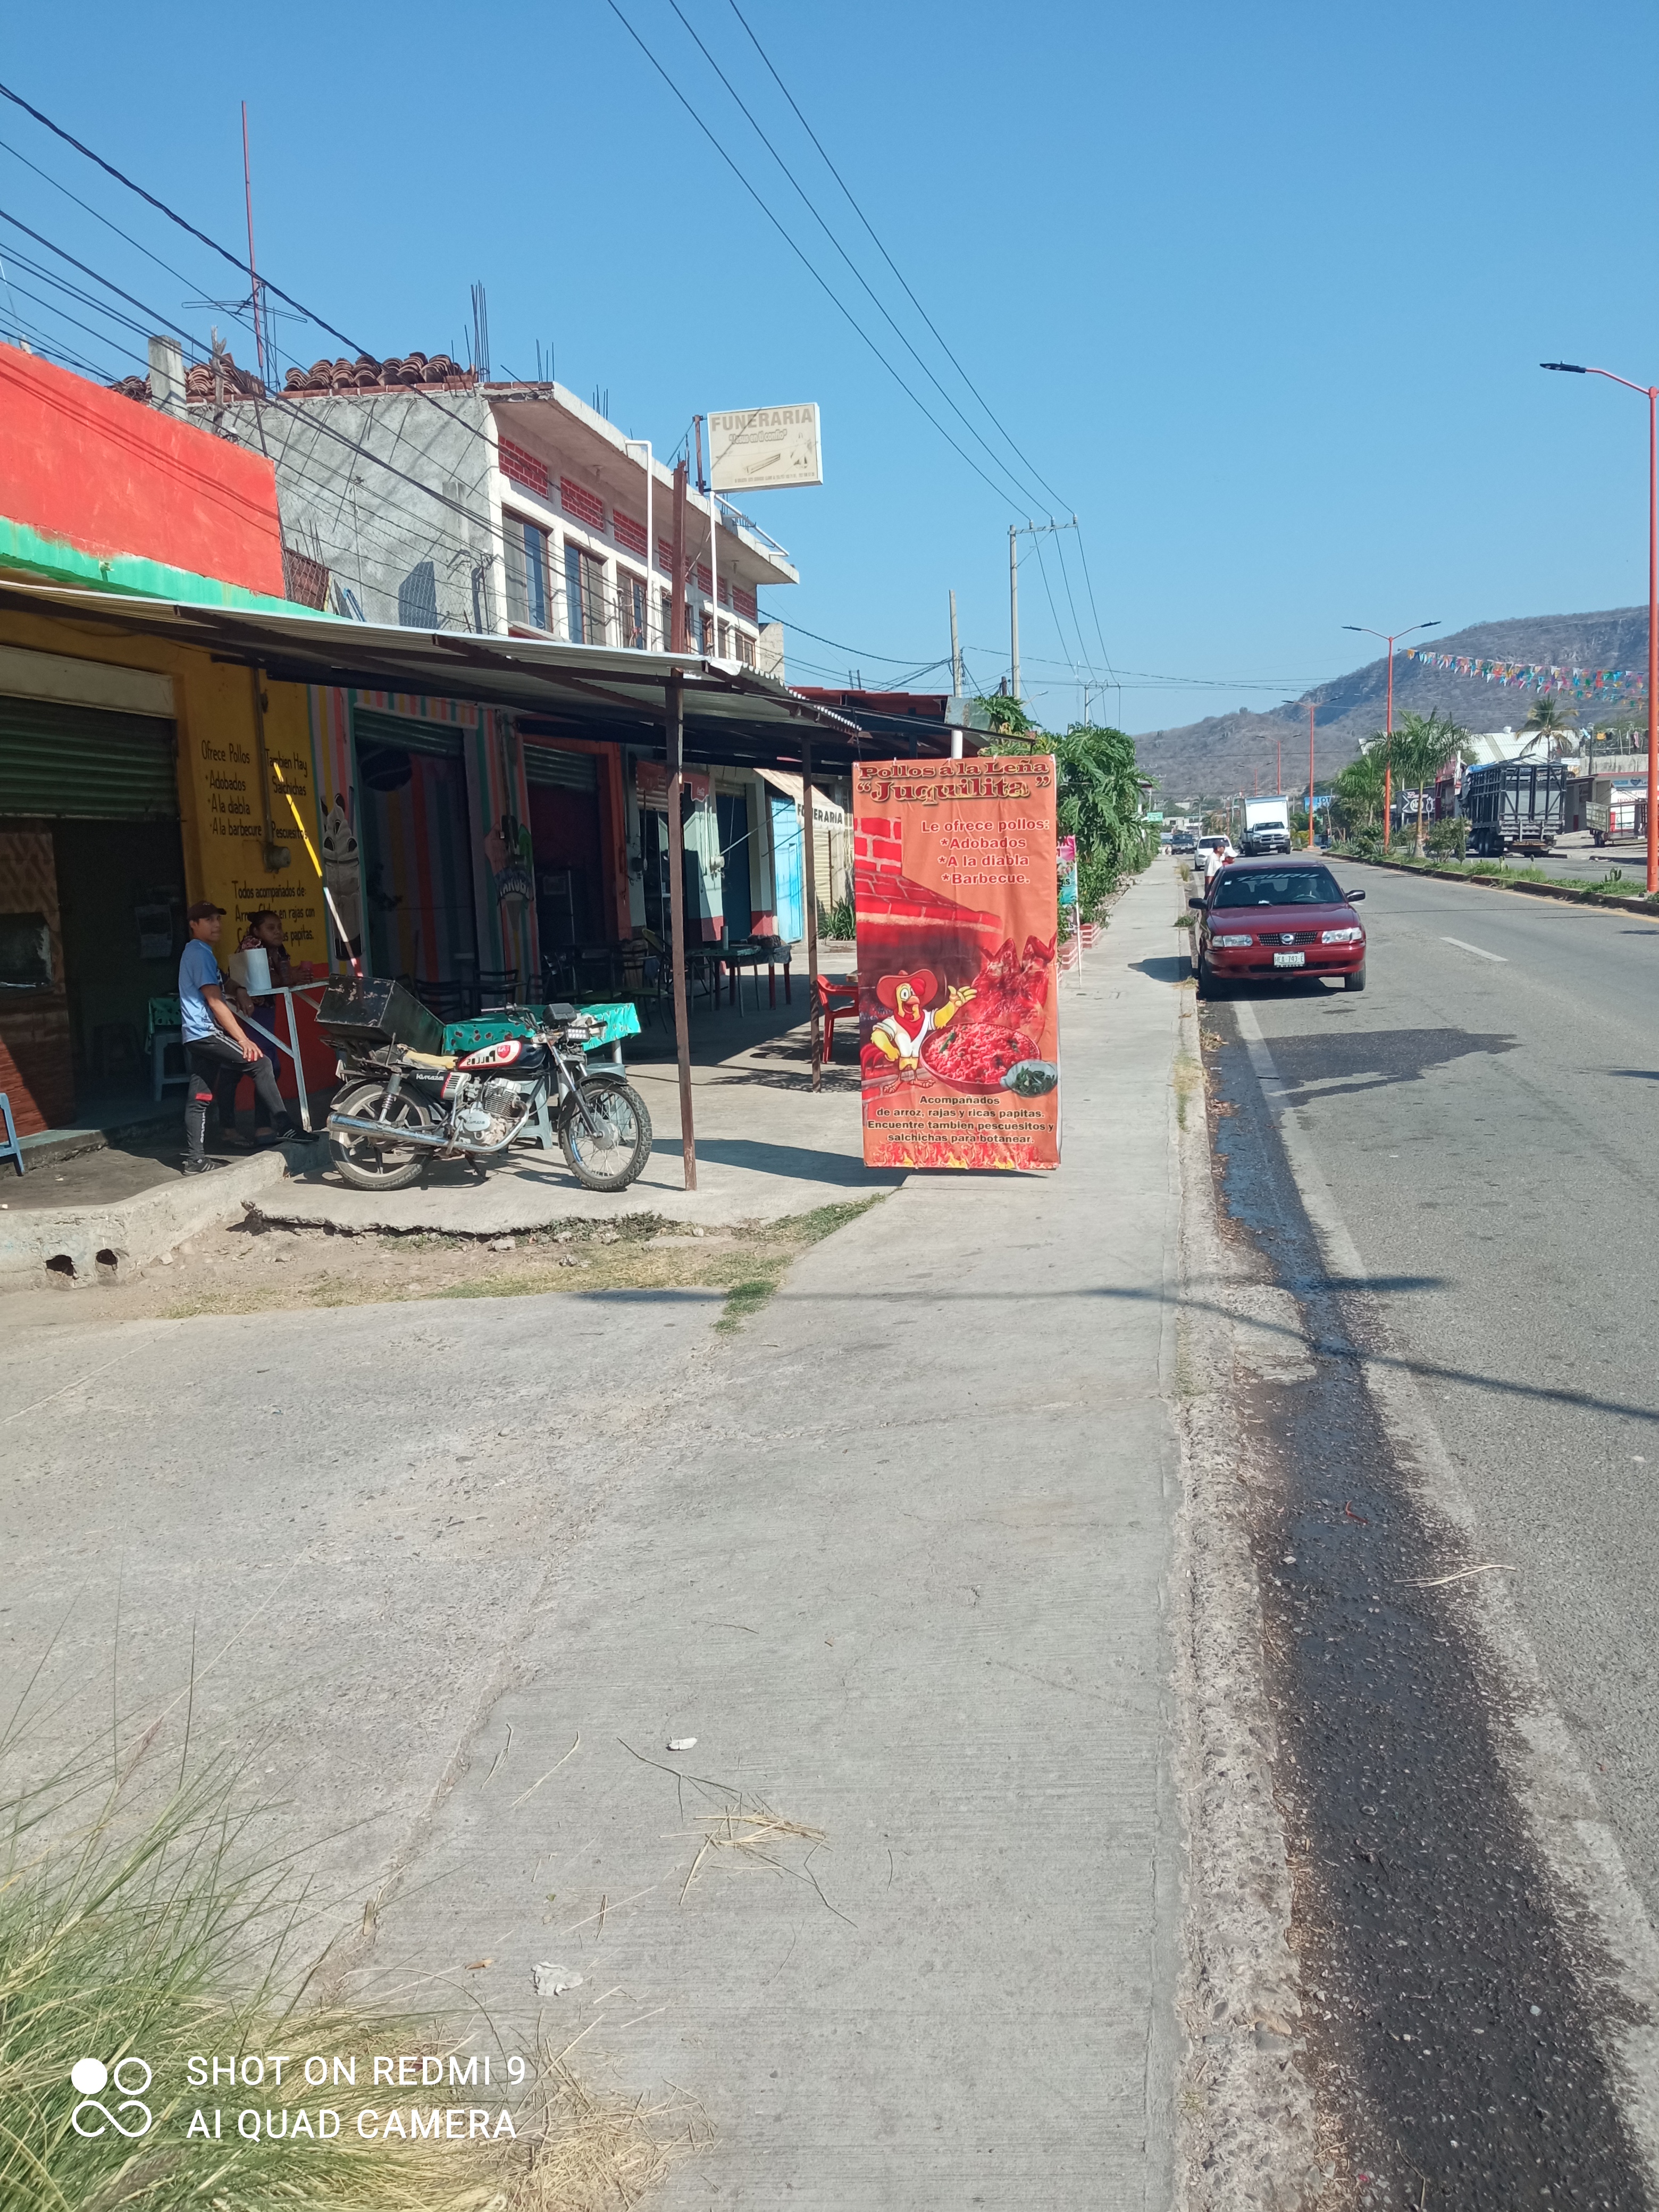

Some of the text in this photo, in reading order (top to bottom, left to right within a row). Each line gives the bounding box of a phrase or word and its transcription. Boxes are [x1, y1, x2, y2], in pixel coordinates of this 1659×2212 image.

[711, 408, 812, 431] FUNERARIA
[201, 740, 250, 764] Ofrece Pollos
[265, 748, 307, 777] Tambien Hay
[859, 765, 935, 779] Pollos
[956, 762, 981, 775] la
[984, 759, 1049, 774] Leña
[219, 794, 226, 814] la
[228, 795, 250, 815] diabla
[798, 803, 842, 824] FERARIA
[219, 818, 226, 836] la
[921, 818, 1050, 833] Le ofrece pollos:
[963, 855, 976, 867] la
[982, 854, 1029, 867] diabla
[231, 880, 254, 899] Todos
[255, 880, 295, 903] acompañados
[289, 906, 304, 923] rajas
[306, 908, 315, 918] con
[919, 1095, 1000, 1105] Acompañados
[876, 1108, 890, 1117] de
[894, 1109, 924, 1118] arroz,
[928, 1109, 956, 1118] rajas
[999, 1109, 1044, 1119] papitas.
[868, 1121, 1054, 1132] Encuentre tambien pescuesitos y
[888, 1134, 1034, 1144] salchichas para botanear.
